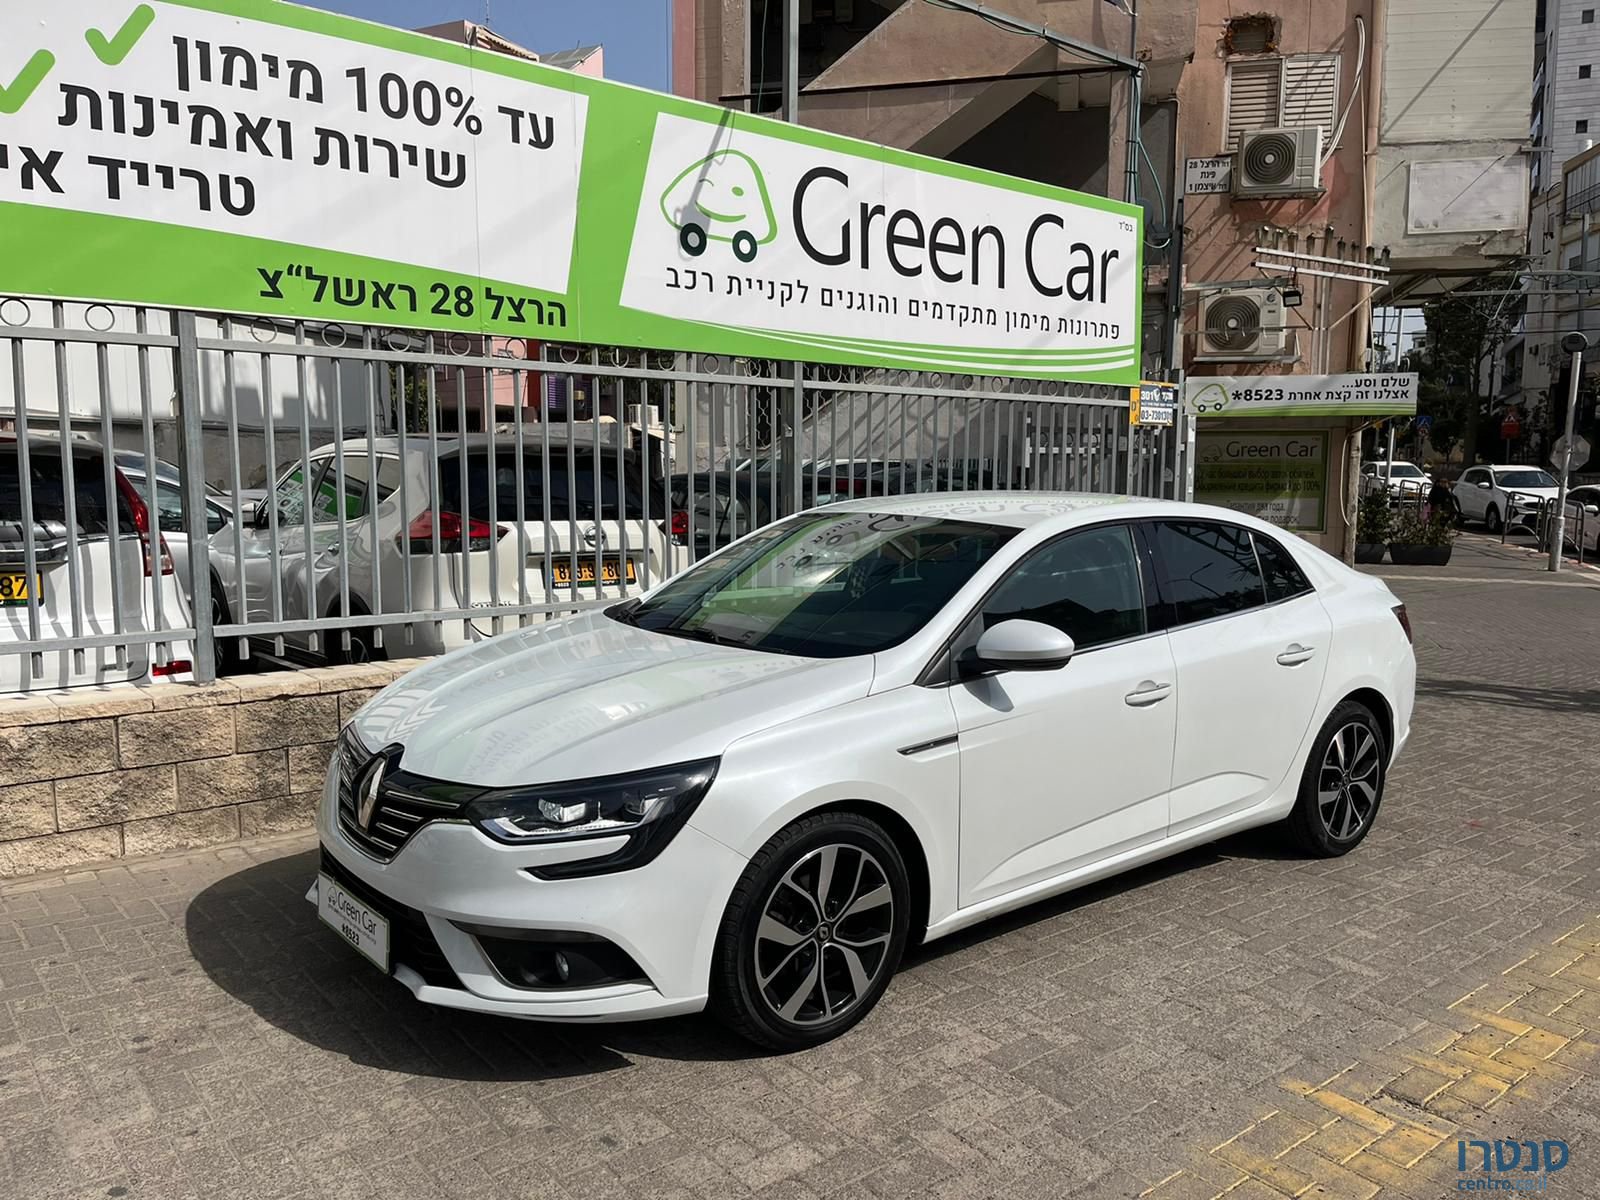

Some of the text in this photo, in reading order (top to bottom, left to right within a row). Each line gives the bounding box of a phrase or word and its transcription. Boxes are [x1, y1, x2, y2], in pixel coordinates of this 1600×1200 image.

[172, 35, 554, 150] עד 100% מימון
[57, 83, 467, 189] שירות ואמינות
[87, 155, 256, 217] טרייד
[1199, 170, 1217, 179] פינת
[792, 166, 1118, 304] Green Car
[428, 282, 475, 318] 28
[484, 286, 567, 328] הרצל
[665, 266, 1120, 340] פתרונות מימון מתקדמים והוגנים לקניית רכב
[1287, 390, 1322, 401] אחרת
[1324, 389, 1351, 402] קצת
[1355, 389, 1370, 399] זה
[1373, 388, 1409, 399] אצלנו
[1381, 376, 1410, 387] שלם
[1226, 440, 1318, 458] Green Car
[337, 891, 361, 925] Green
[362, 910, 377, 936] Car
